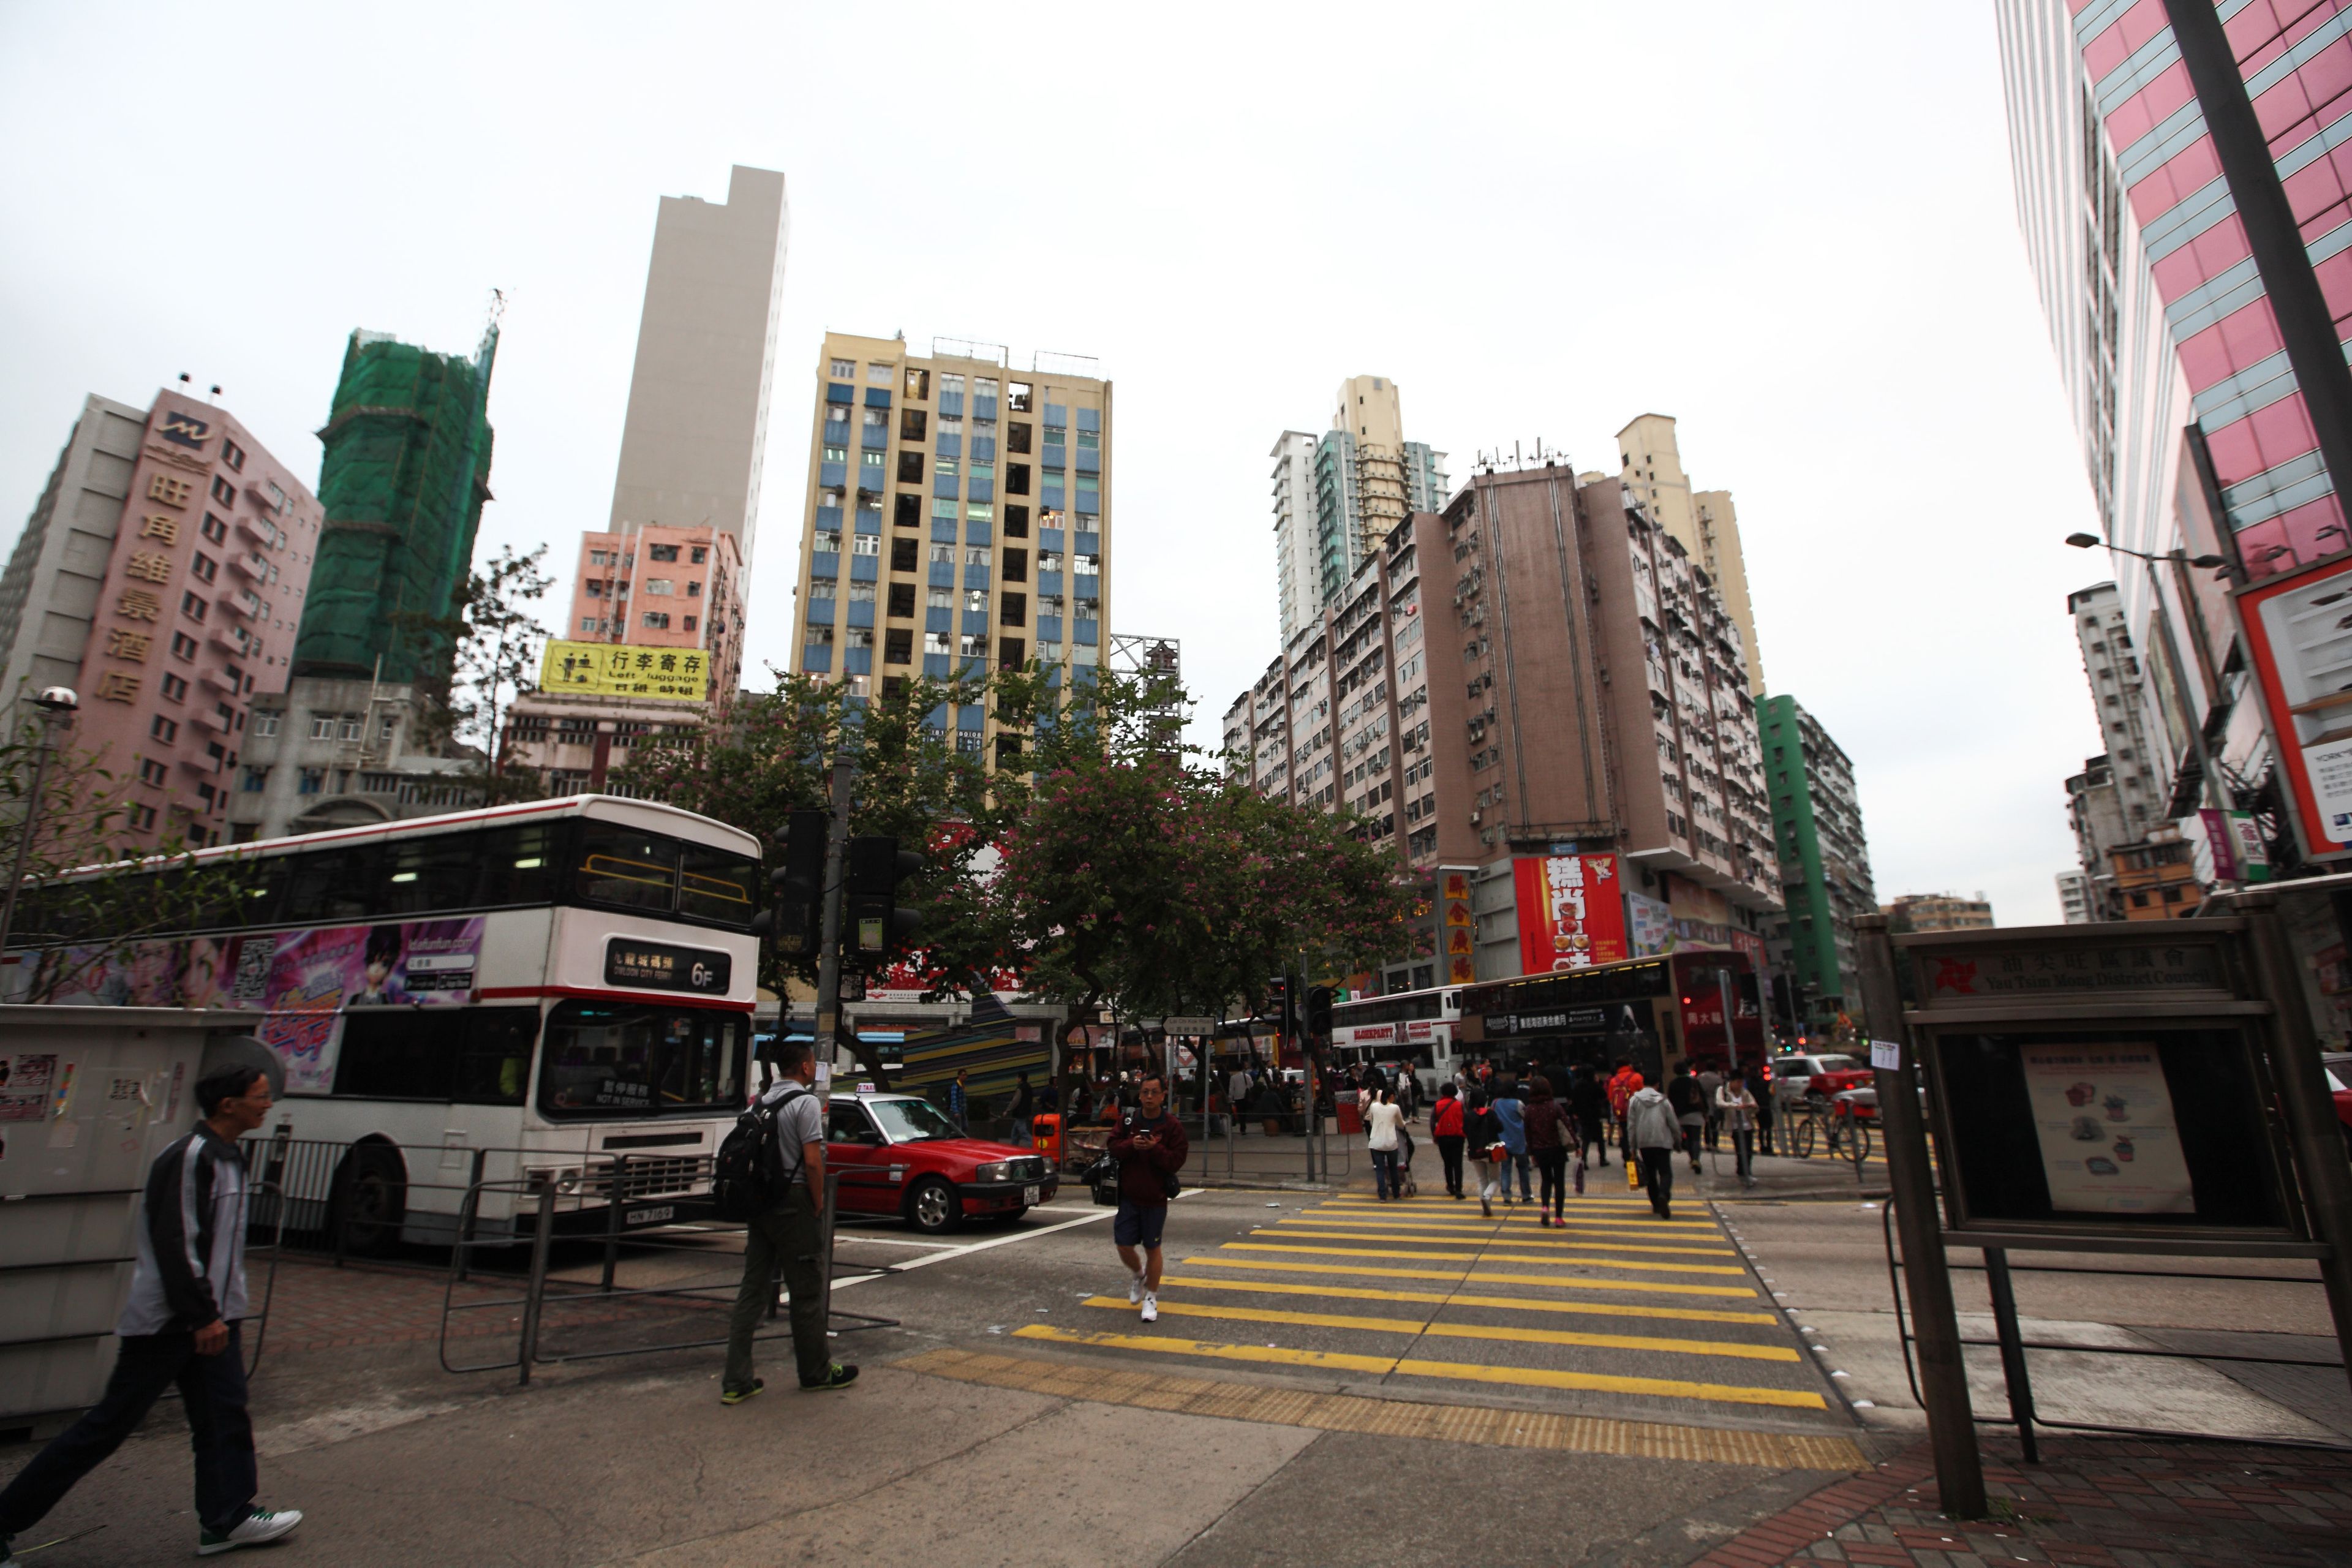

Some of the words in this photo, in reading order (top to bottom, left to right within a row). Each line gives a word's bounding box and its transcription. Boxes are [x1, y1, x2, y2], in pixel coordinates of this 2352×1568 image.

[94, 472, 193, 706] 旺角維景酒店
[612, 651, 701, 673] 行李寄存
[647, 673, 698, 682] luggage
[2003, 947, 2185, 973] 油尖旺區議會
[691, 962, 714, 987] 6F
[1986, 976, 2013, 990] Yau
[2015, 974, 2051, 989] Tsim
[2056, 974, 2094, 990] Mong
[2097, 971, 2152, 987] District
[2154, 968, 2211, 985] Council
[1687, 1011, 1723, 1025] 周大福
[603, 1080, 649, 1097] 暫停服務
[596, 1093, 612, 1104] NOT
[612, 1095, 620, 1104] IN
[621, 1096, 650, 1107] SERVICE
